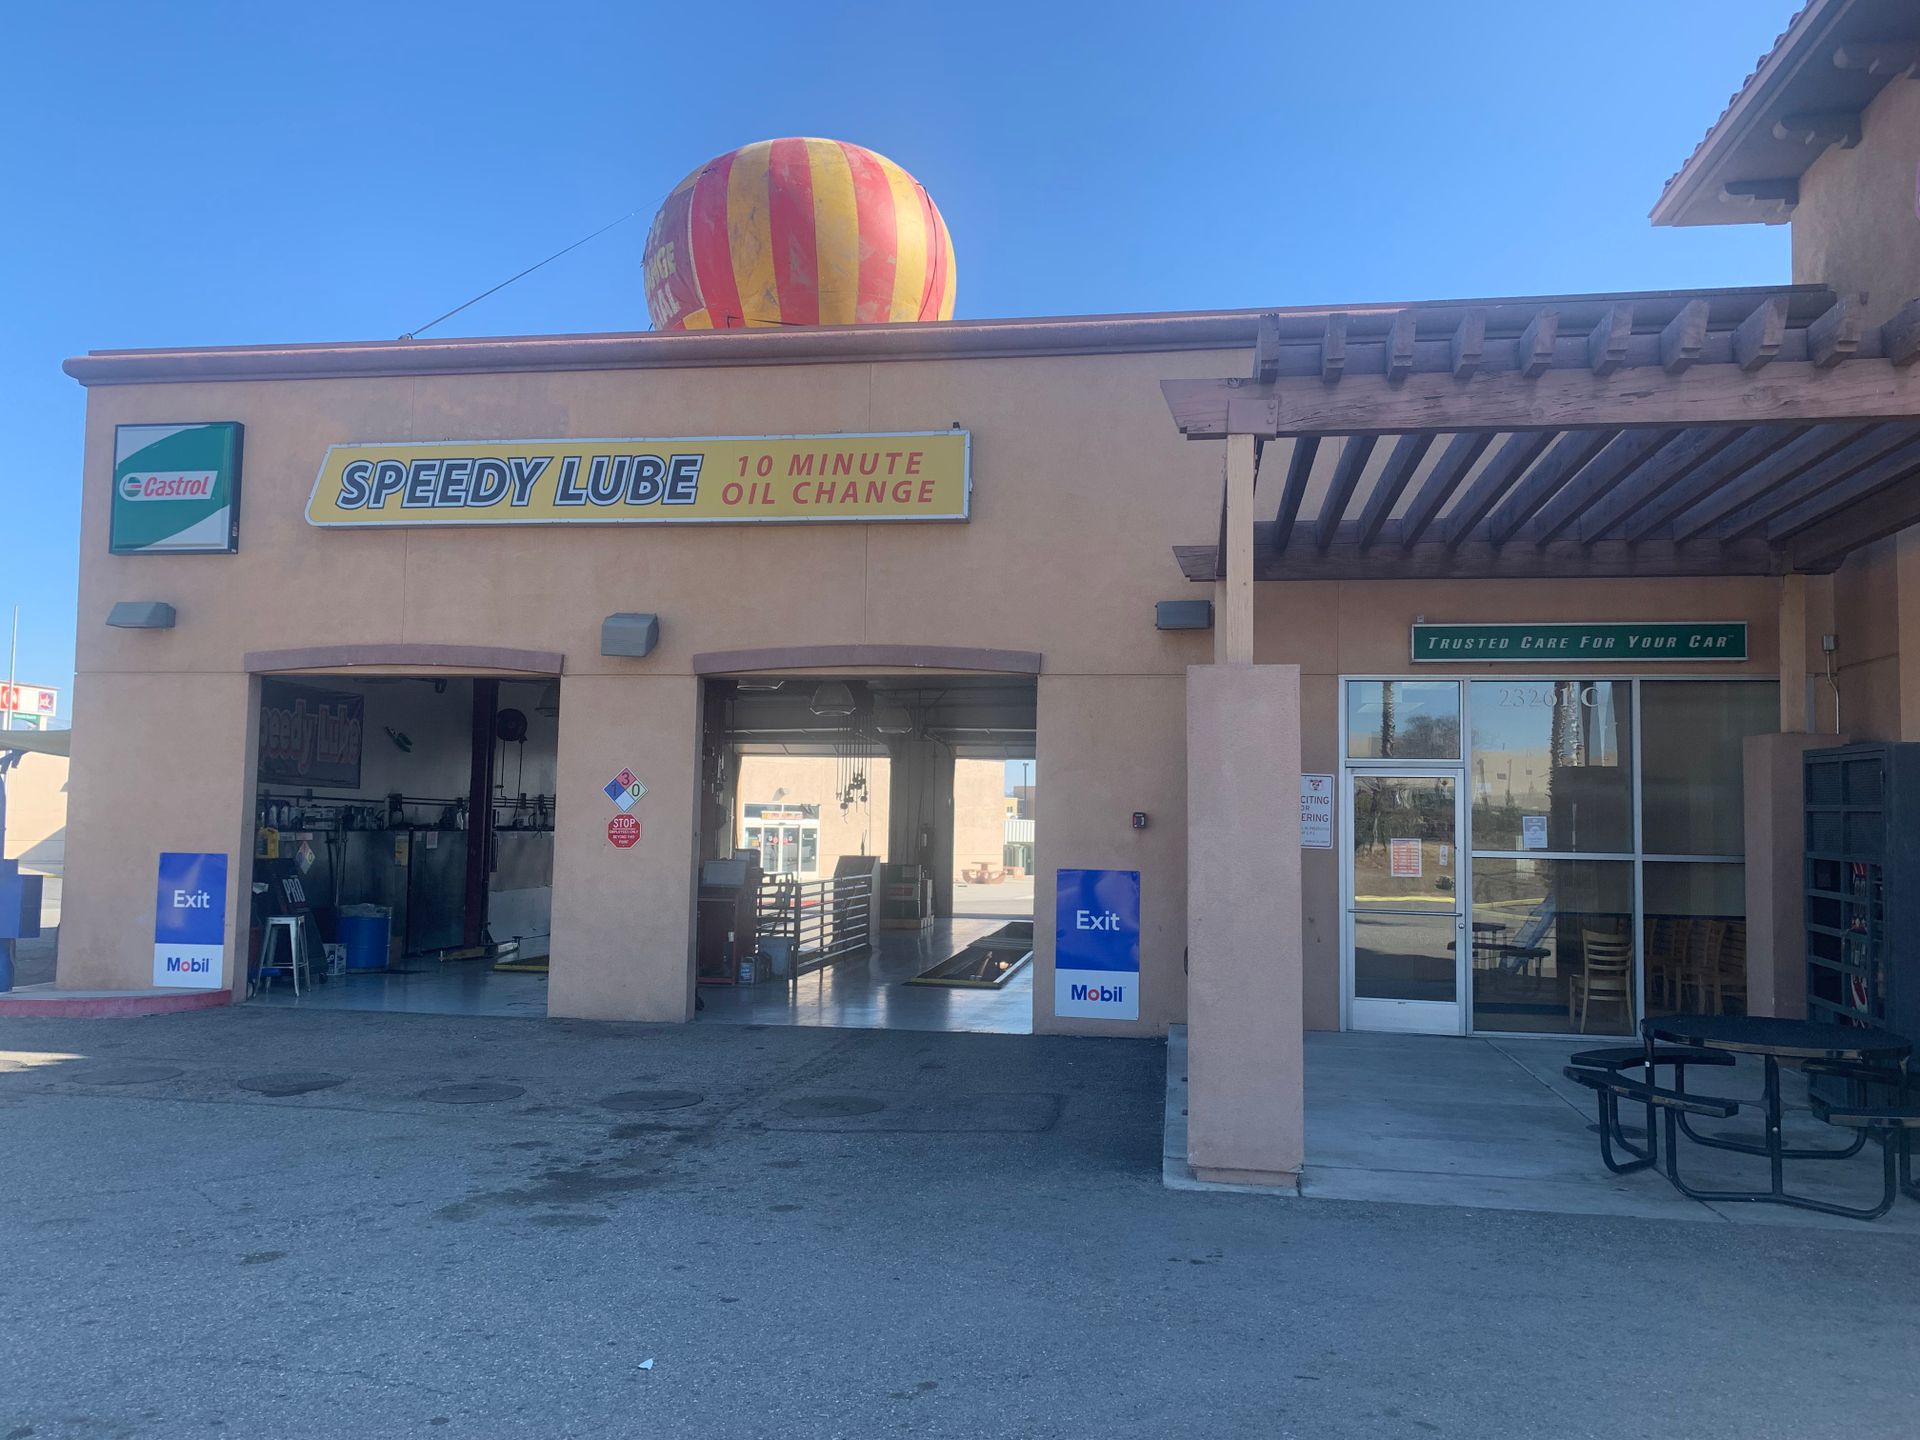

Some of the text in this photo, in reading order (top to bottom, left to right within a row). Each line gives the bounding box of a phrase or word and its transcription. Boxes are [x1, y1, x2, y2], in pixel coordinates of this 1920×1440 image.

[738, 452, 923, 477] 10 MINUTE
[143, 476, 210, 497] Castrol
[336, 453, 704, 510] SPEEDY LUBE
[721, 480, 936, 505] OIL CHANGE
[1581, 687, 1601, 707] C
[260, 698, 319, 775] peedy
[621, 772, 630, 786] 3
[611, 784, 640, 797] 1 0
[1301, 795, 1329, 805] CITING
[613, 818, 636, 828] STOP
[1301, 813, 1329, 823] ERING
[173, 889, 210, 909] Exit
[1076, 909, 1120, 931] Exit
[167, 957, 209, 972] Mobil
[1071, 984, 1122, 1002] Mobil
